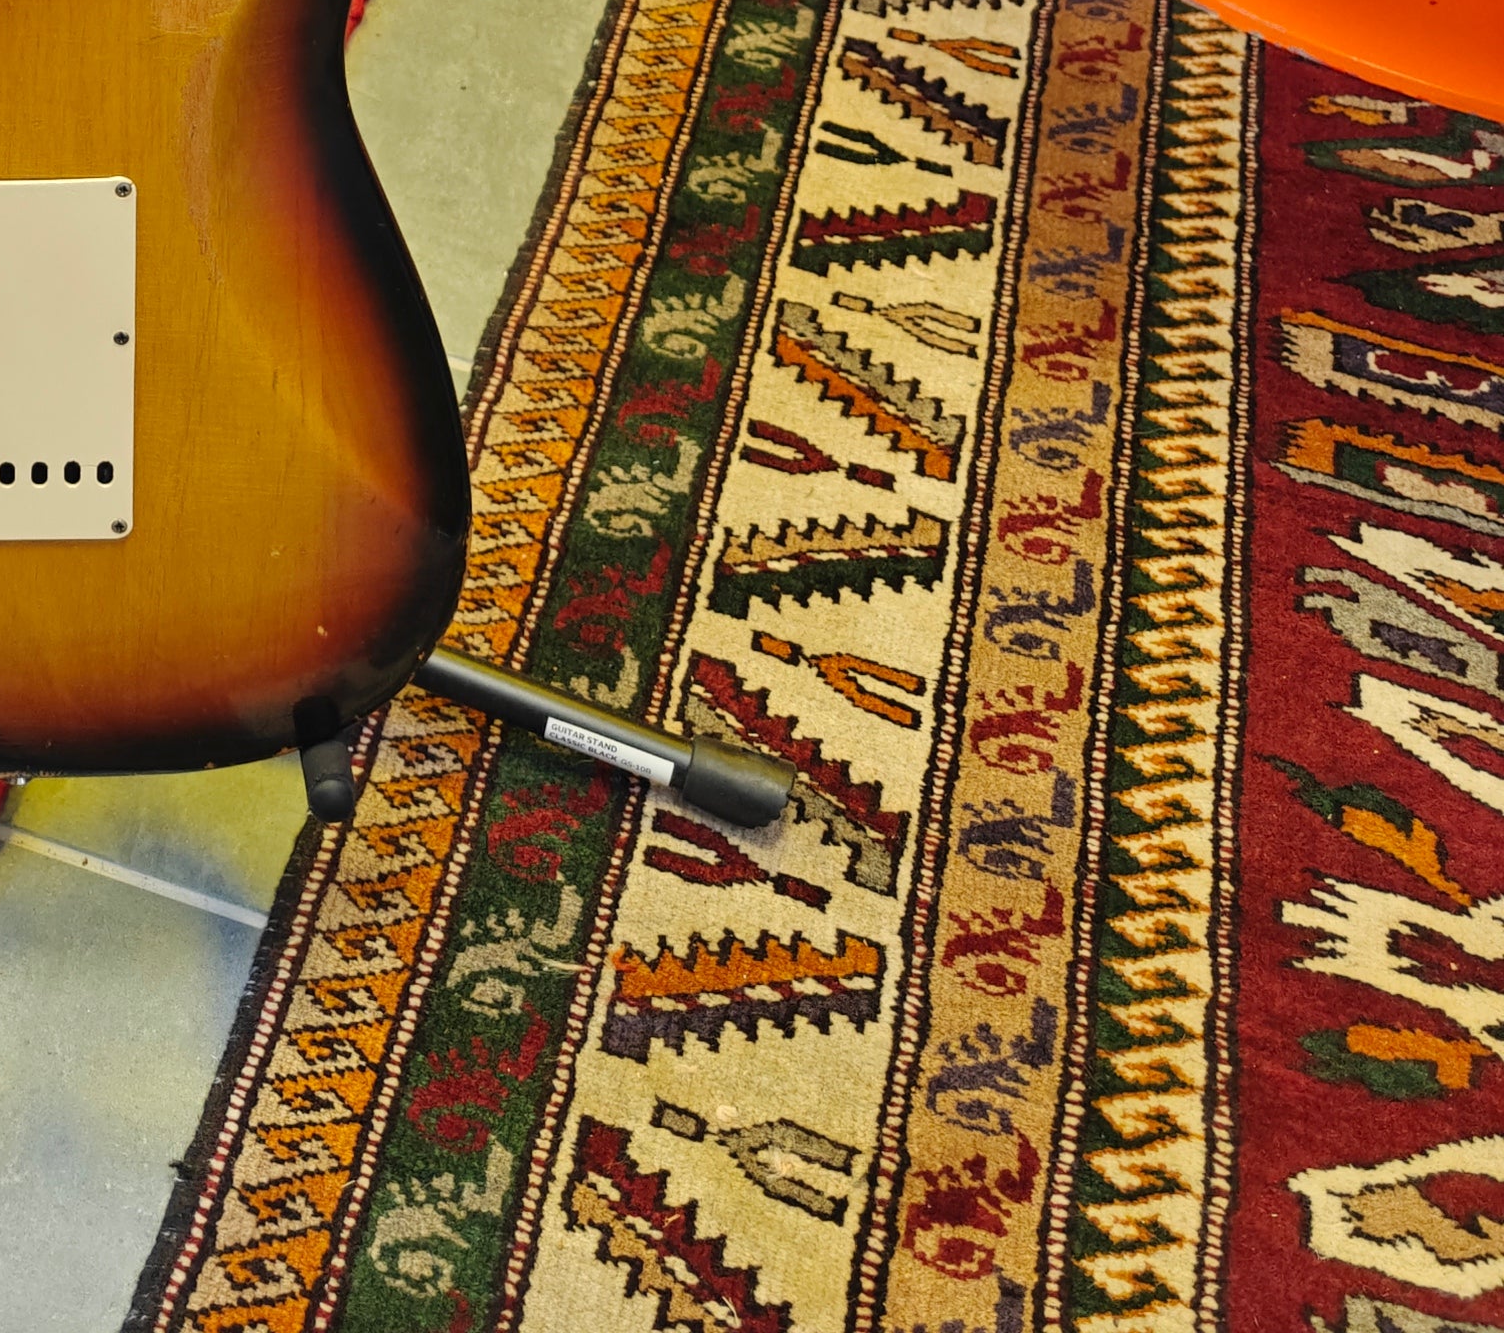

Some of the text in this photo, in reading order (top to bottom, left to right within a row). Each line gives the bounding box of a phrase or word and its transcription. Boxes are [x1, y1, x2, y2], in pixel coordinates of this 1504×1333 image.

[549, 732, 586, 750] CLASSIC
[587, 745, 618, 761] BLACK
[551, 723, 617, 753] GUITAR STAND
